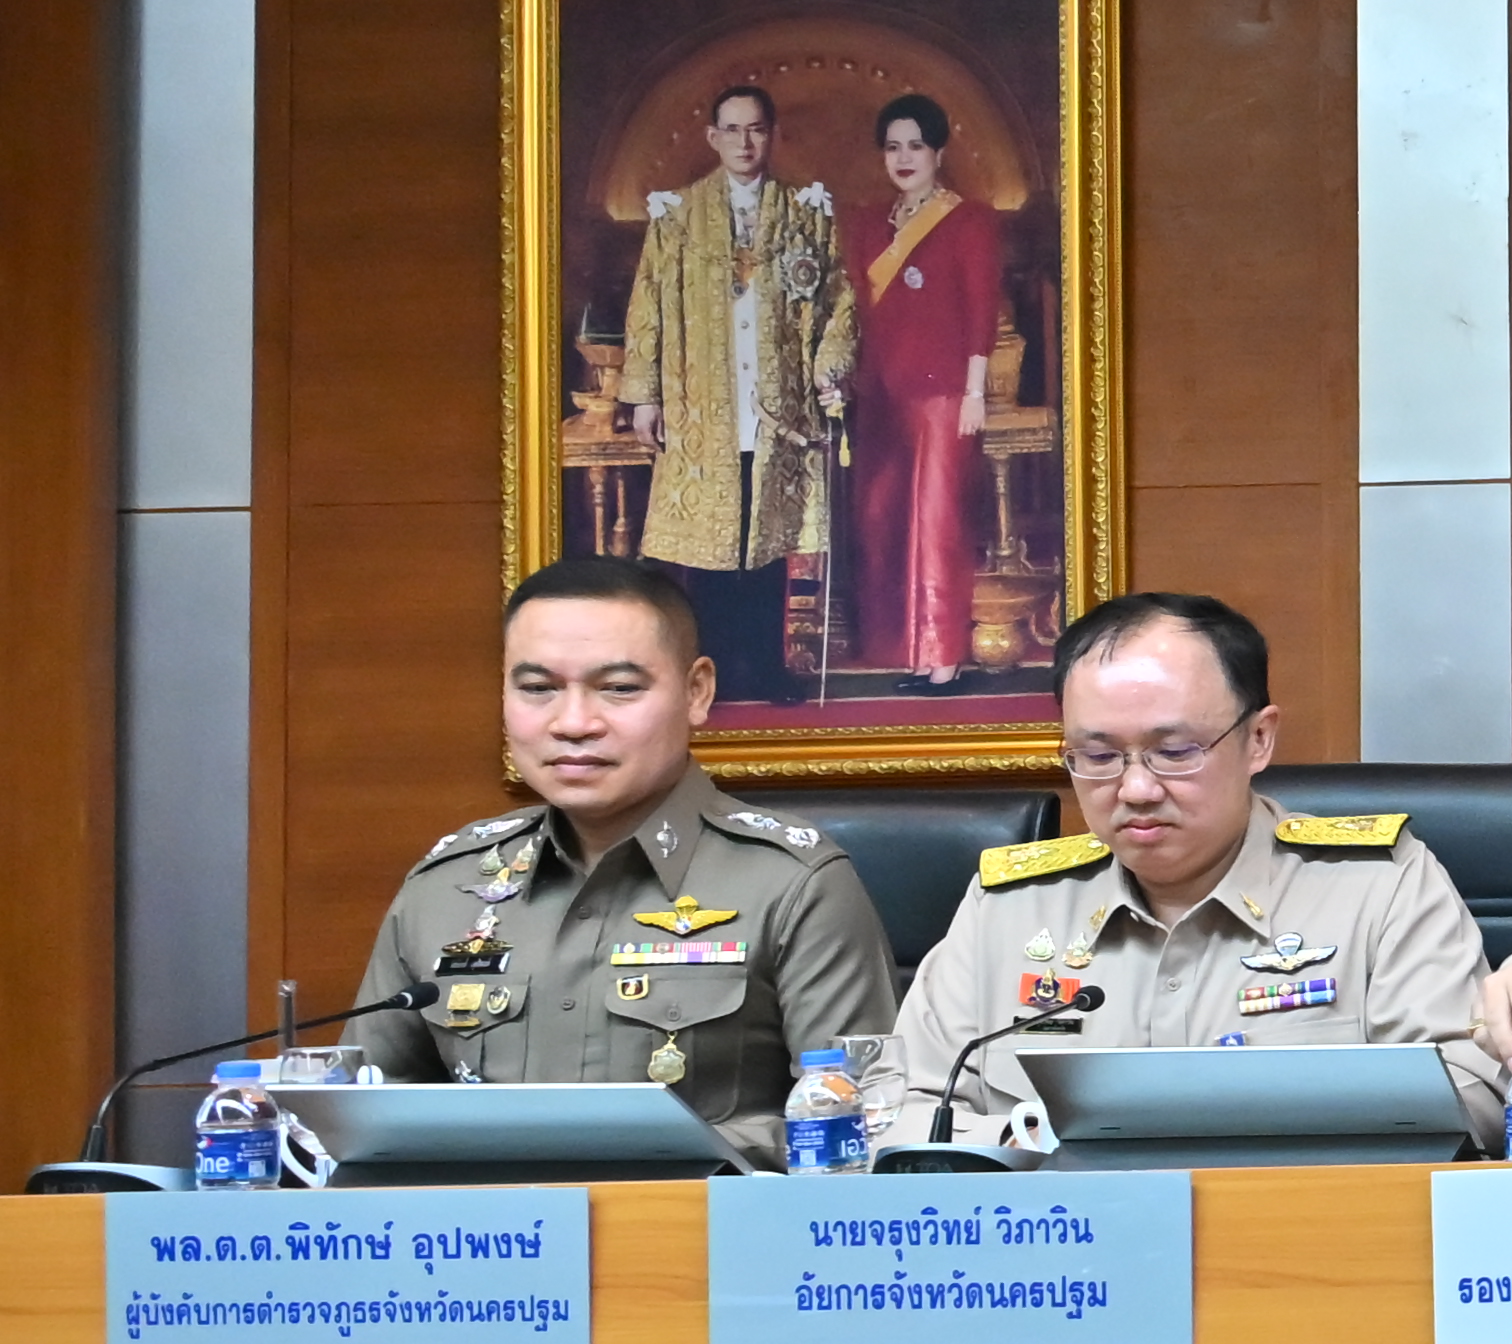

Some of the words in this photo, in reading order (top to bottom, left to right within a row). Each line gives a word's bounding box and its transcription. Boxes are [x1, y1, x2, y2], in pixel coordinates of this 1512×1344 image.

[411, 1219, 544, 1276] อุปพงษ์
[809, 1205, 982, 1263] นายจรุงวิทย์
[993, 1204, 1094, 1245] วิภาวิน
[125, 1289, 569, 1340] ผู้บังคับการตำรวจภูธรจังหวัดนครปฐม
[794, 1269, 1107, 1320] อัยการจังหวัดนครปฐม
